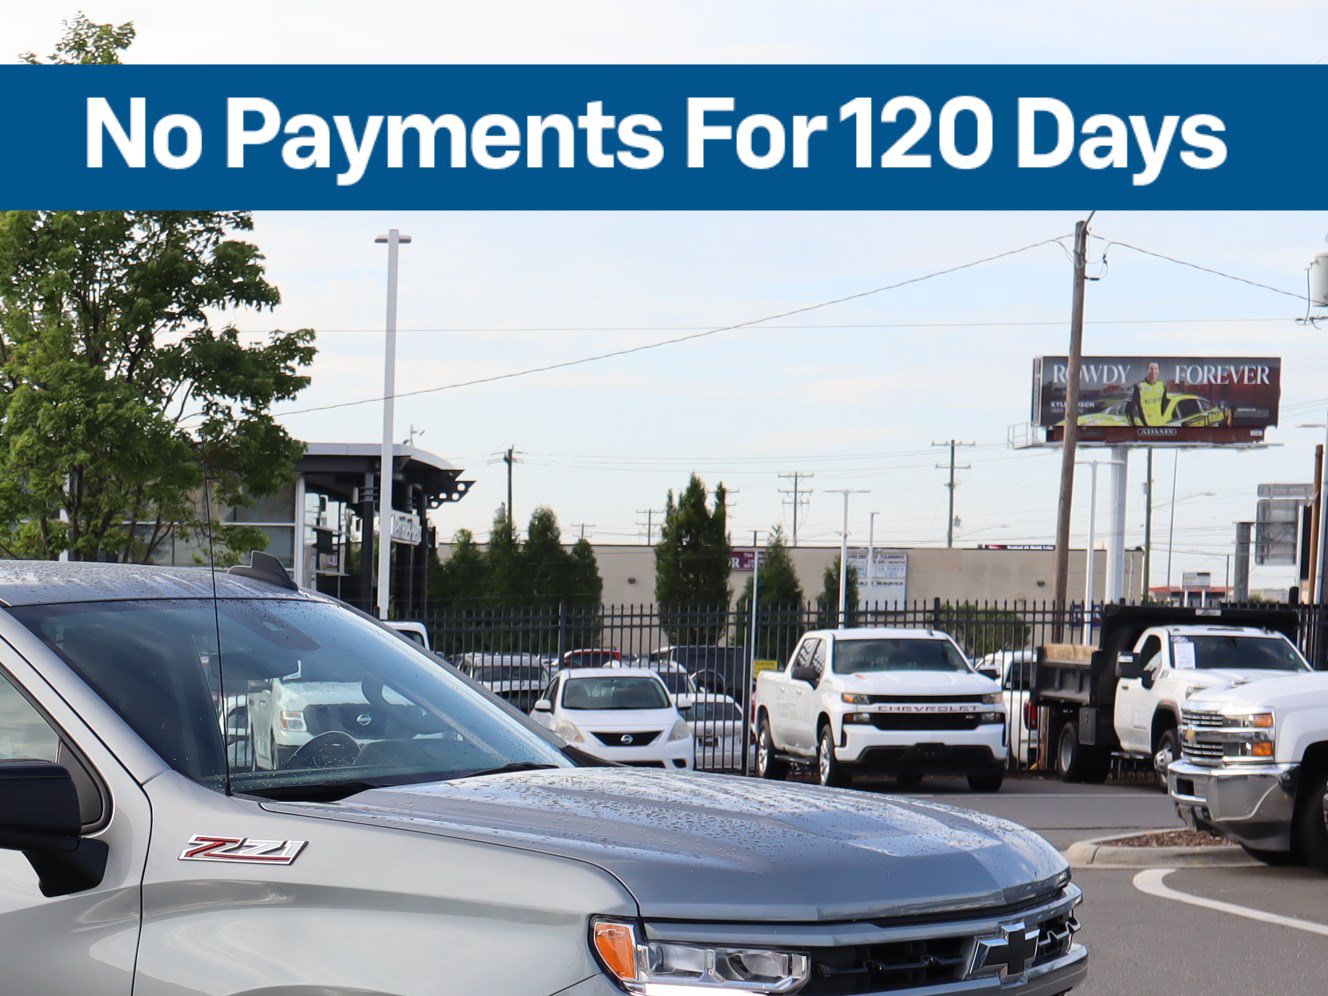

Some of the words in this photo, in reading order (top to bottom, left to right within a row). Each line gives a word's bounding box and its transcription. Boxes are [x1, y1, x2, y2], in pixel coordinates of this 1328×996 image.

[1053, 364, 1131, 384] RWDY
[1175, 364, 1270, 385] FOREVER
[178, 834, 310, 865] Z71
